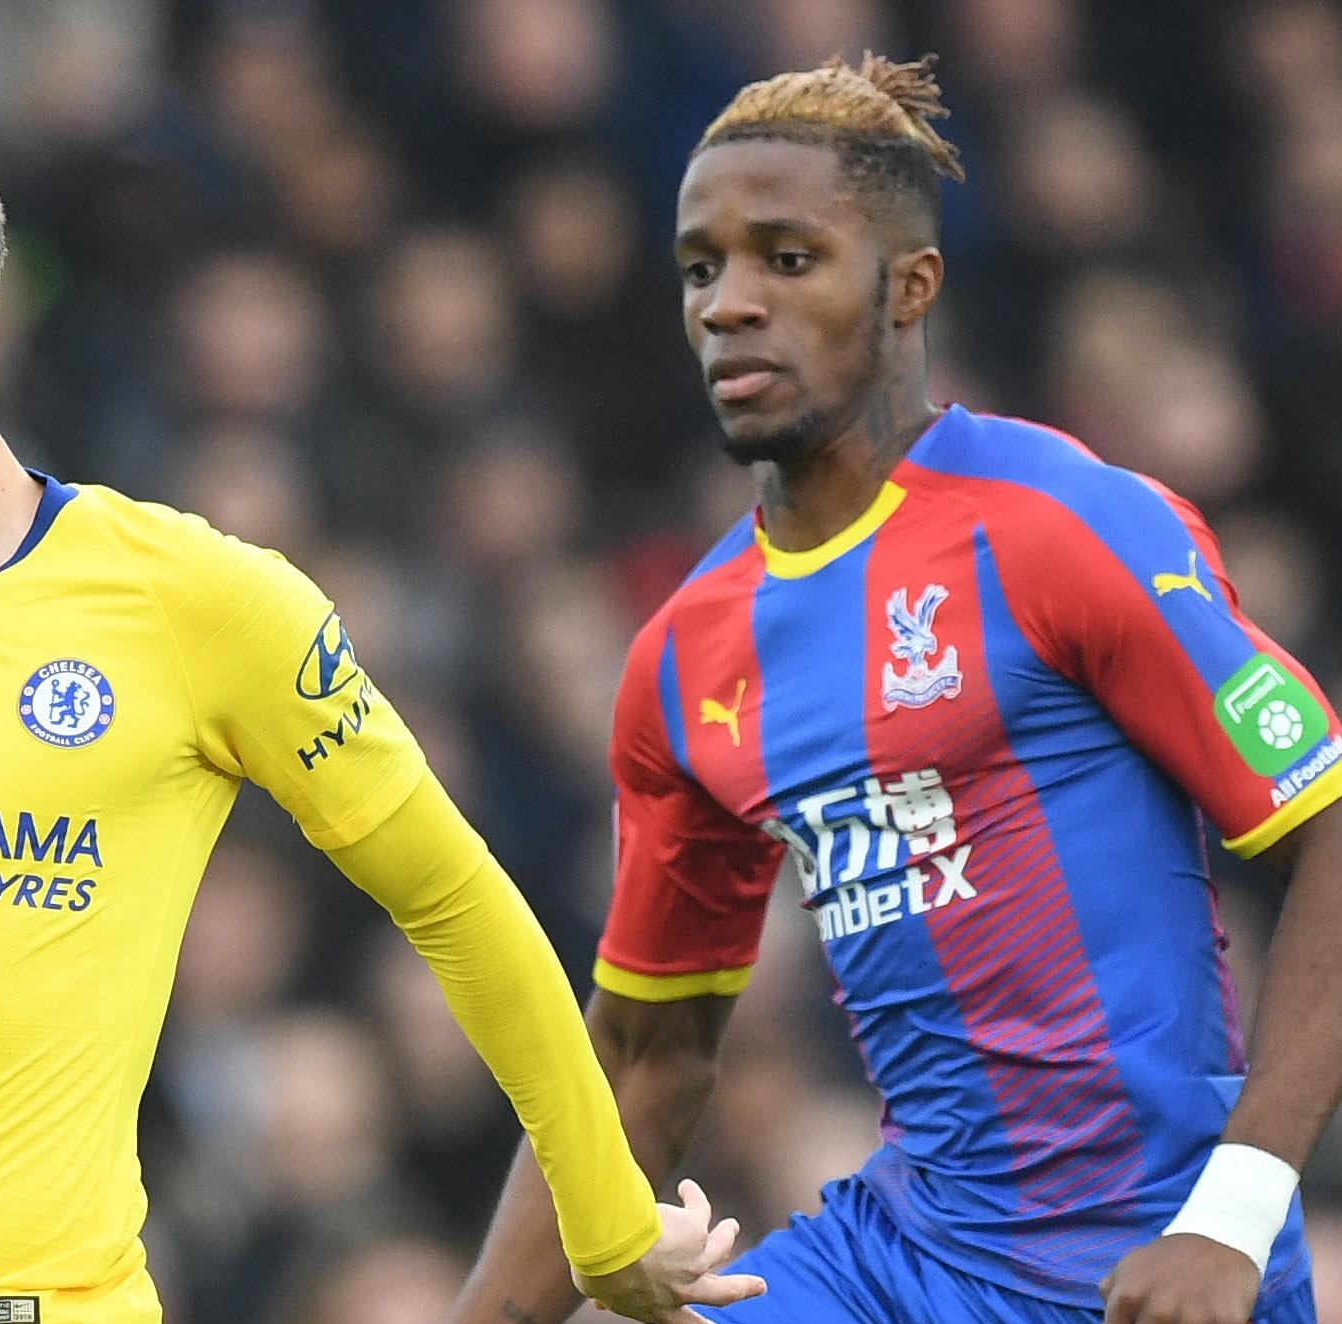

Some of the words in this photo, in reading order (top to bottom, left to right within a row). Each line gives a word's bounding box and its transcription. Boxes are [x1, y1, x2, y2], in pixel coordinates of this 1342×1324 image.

[38, 661, 102, 685] CHELSEA
[29, 723, 71, 746] FOOTBALL
[73, 731, 96, 745] CLUB
